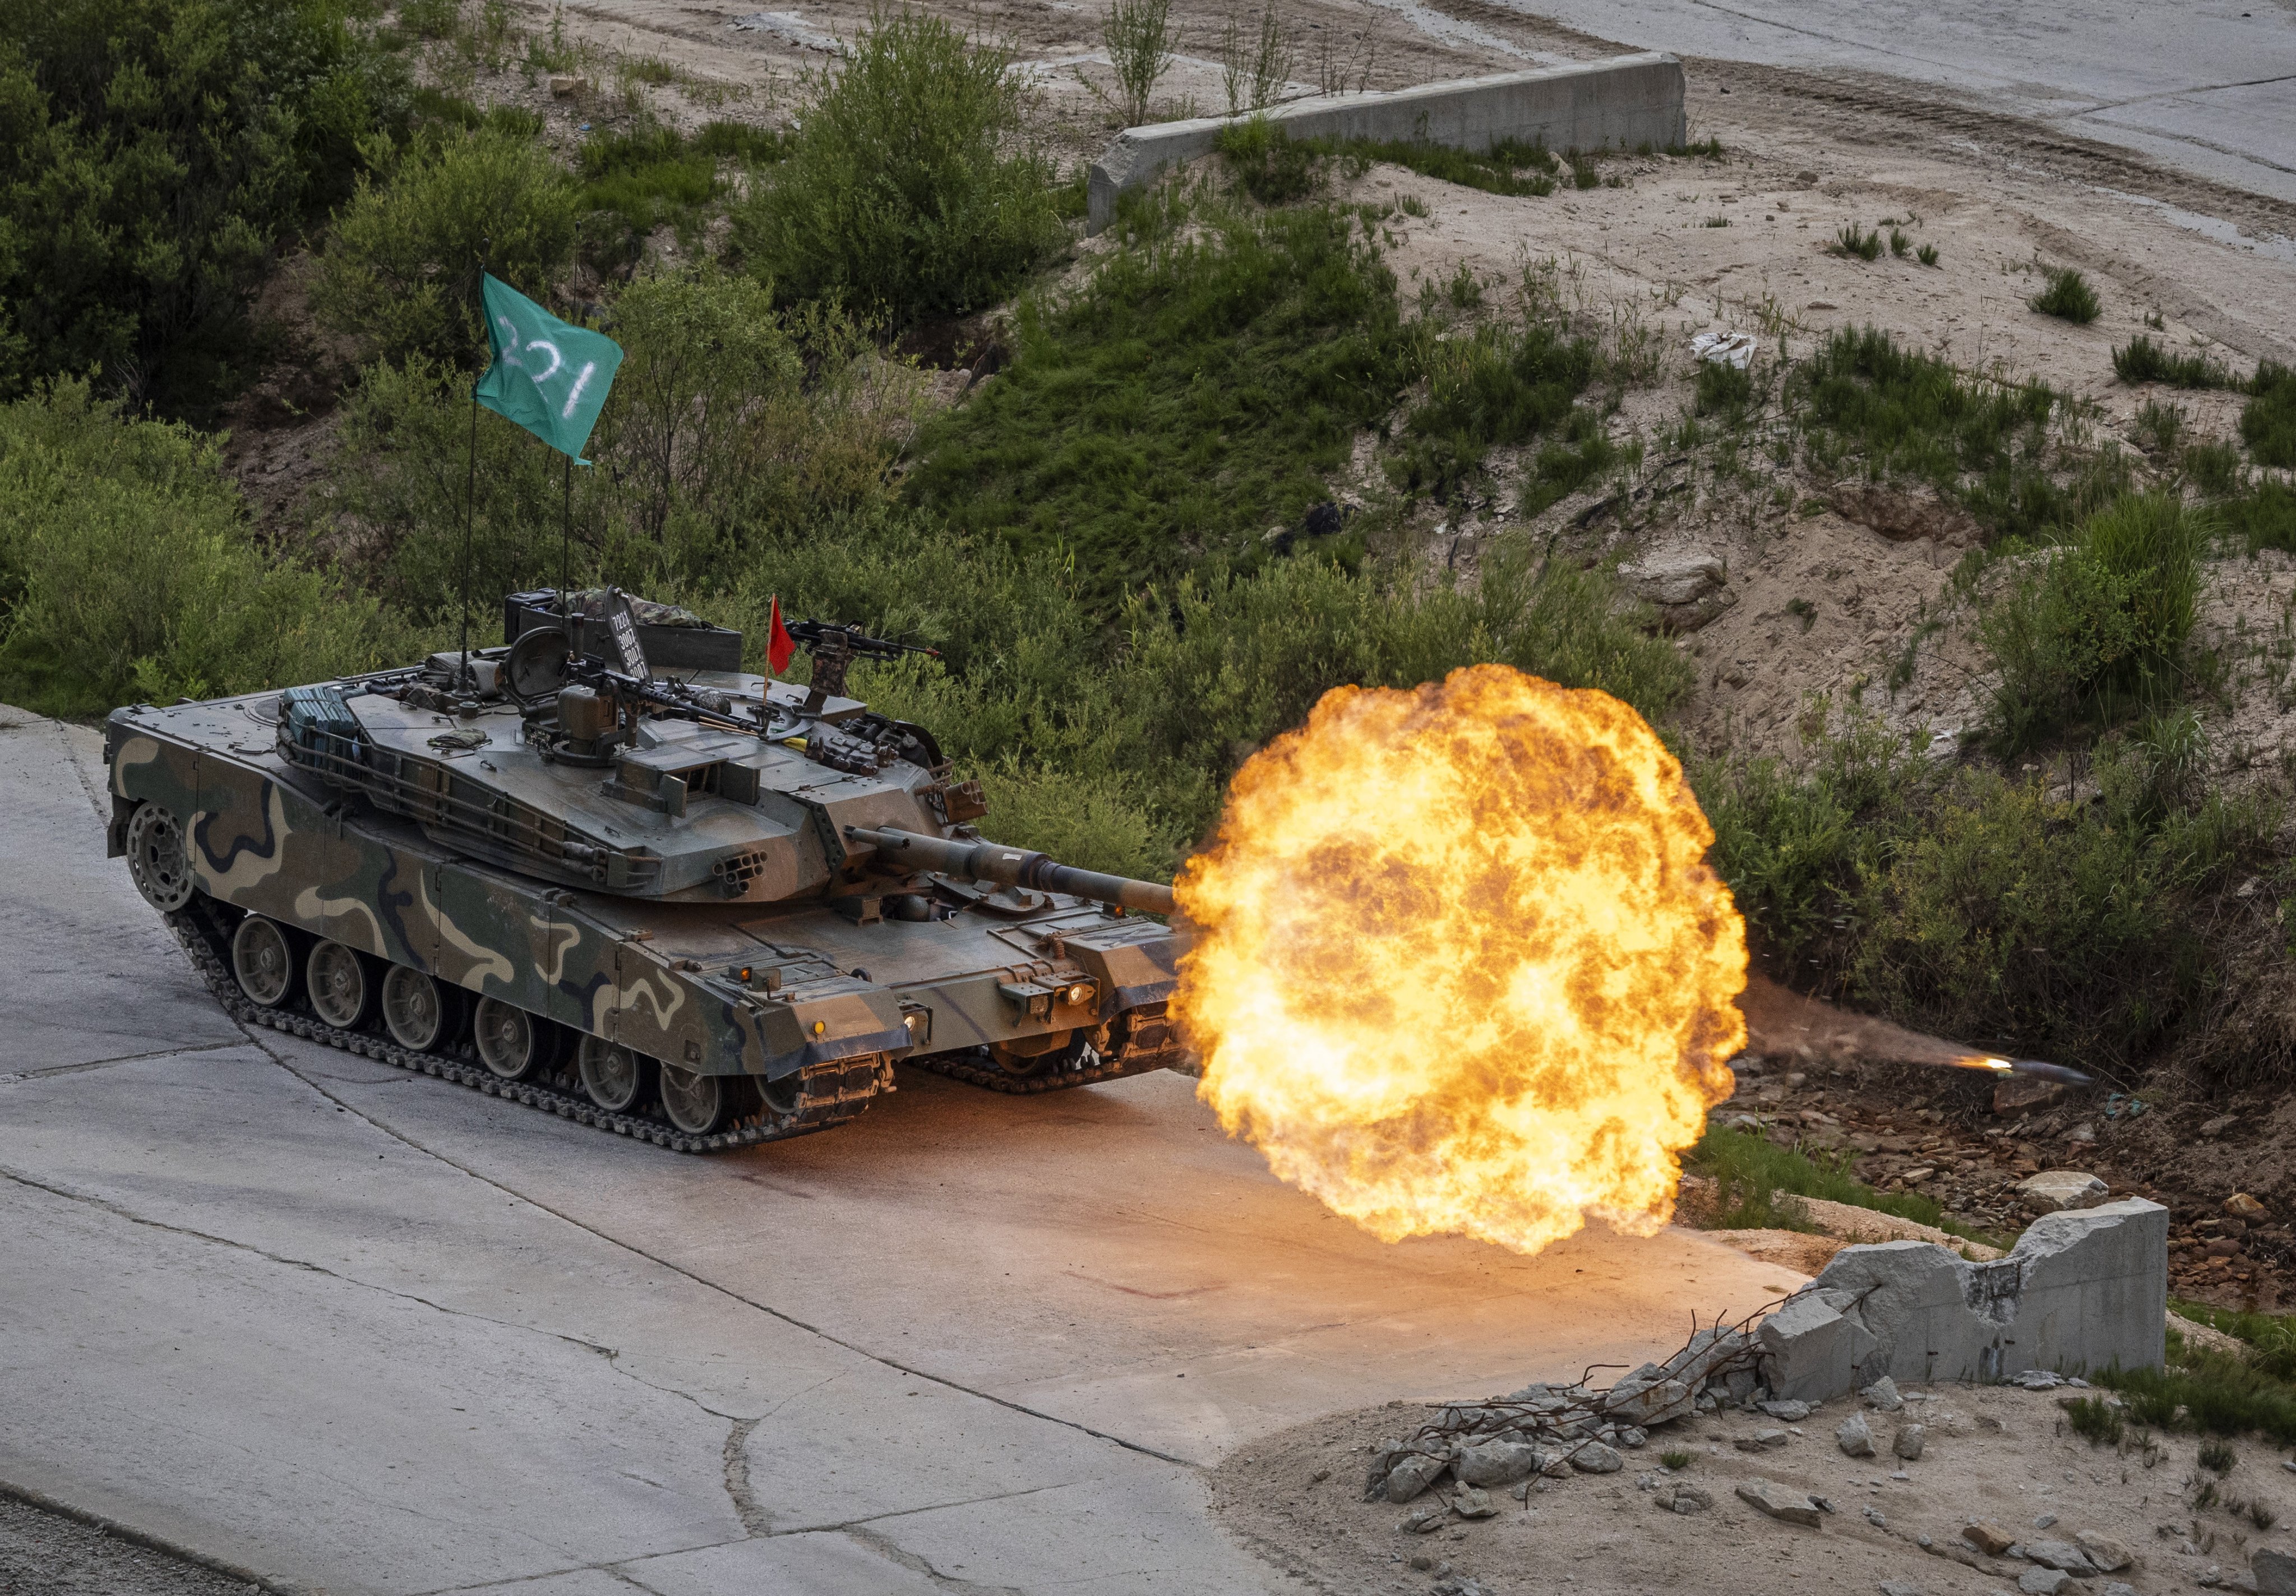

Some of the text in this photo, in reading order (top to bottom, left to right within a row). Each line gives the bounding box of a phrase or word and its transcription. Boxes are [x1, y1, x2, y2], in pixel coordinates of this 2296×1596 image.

[612, 610, 630, 631] 7221
[618, 628, 635, 650] 3007
[625, 645, 641, 667] 3007
